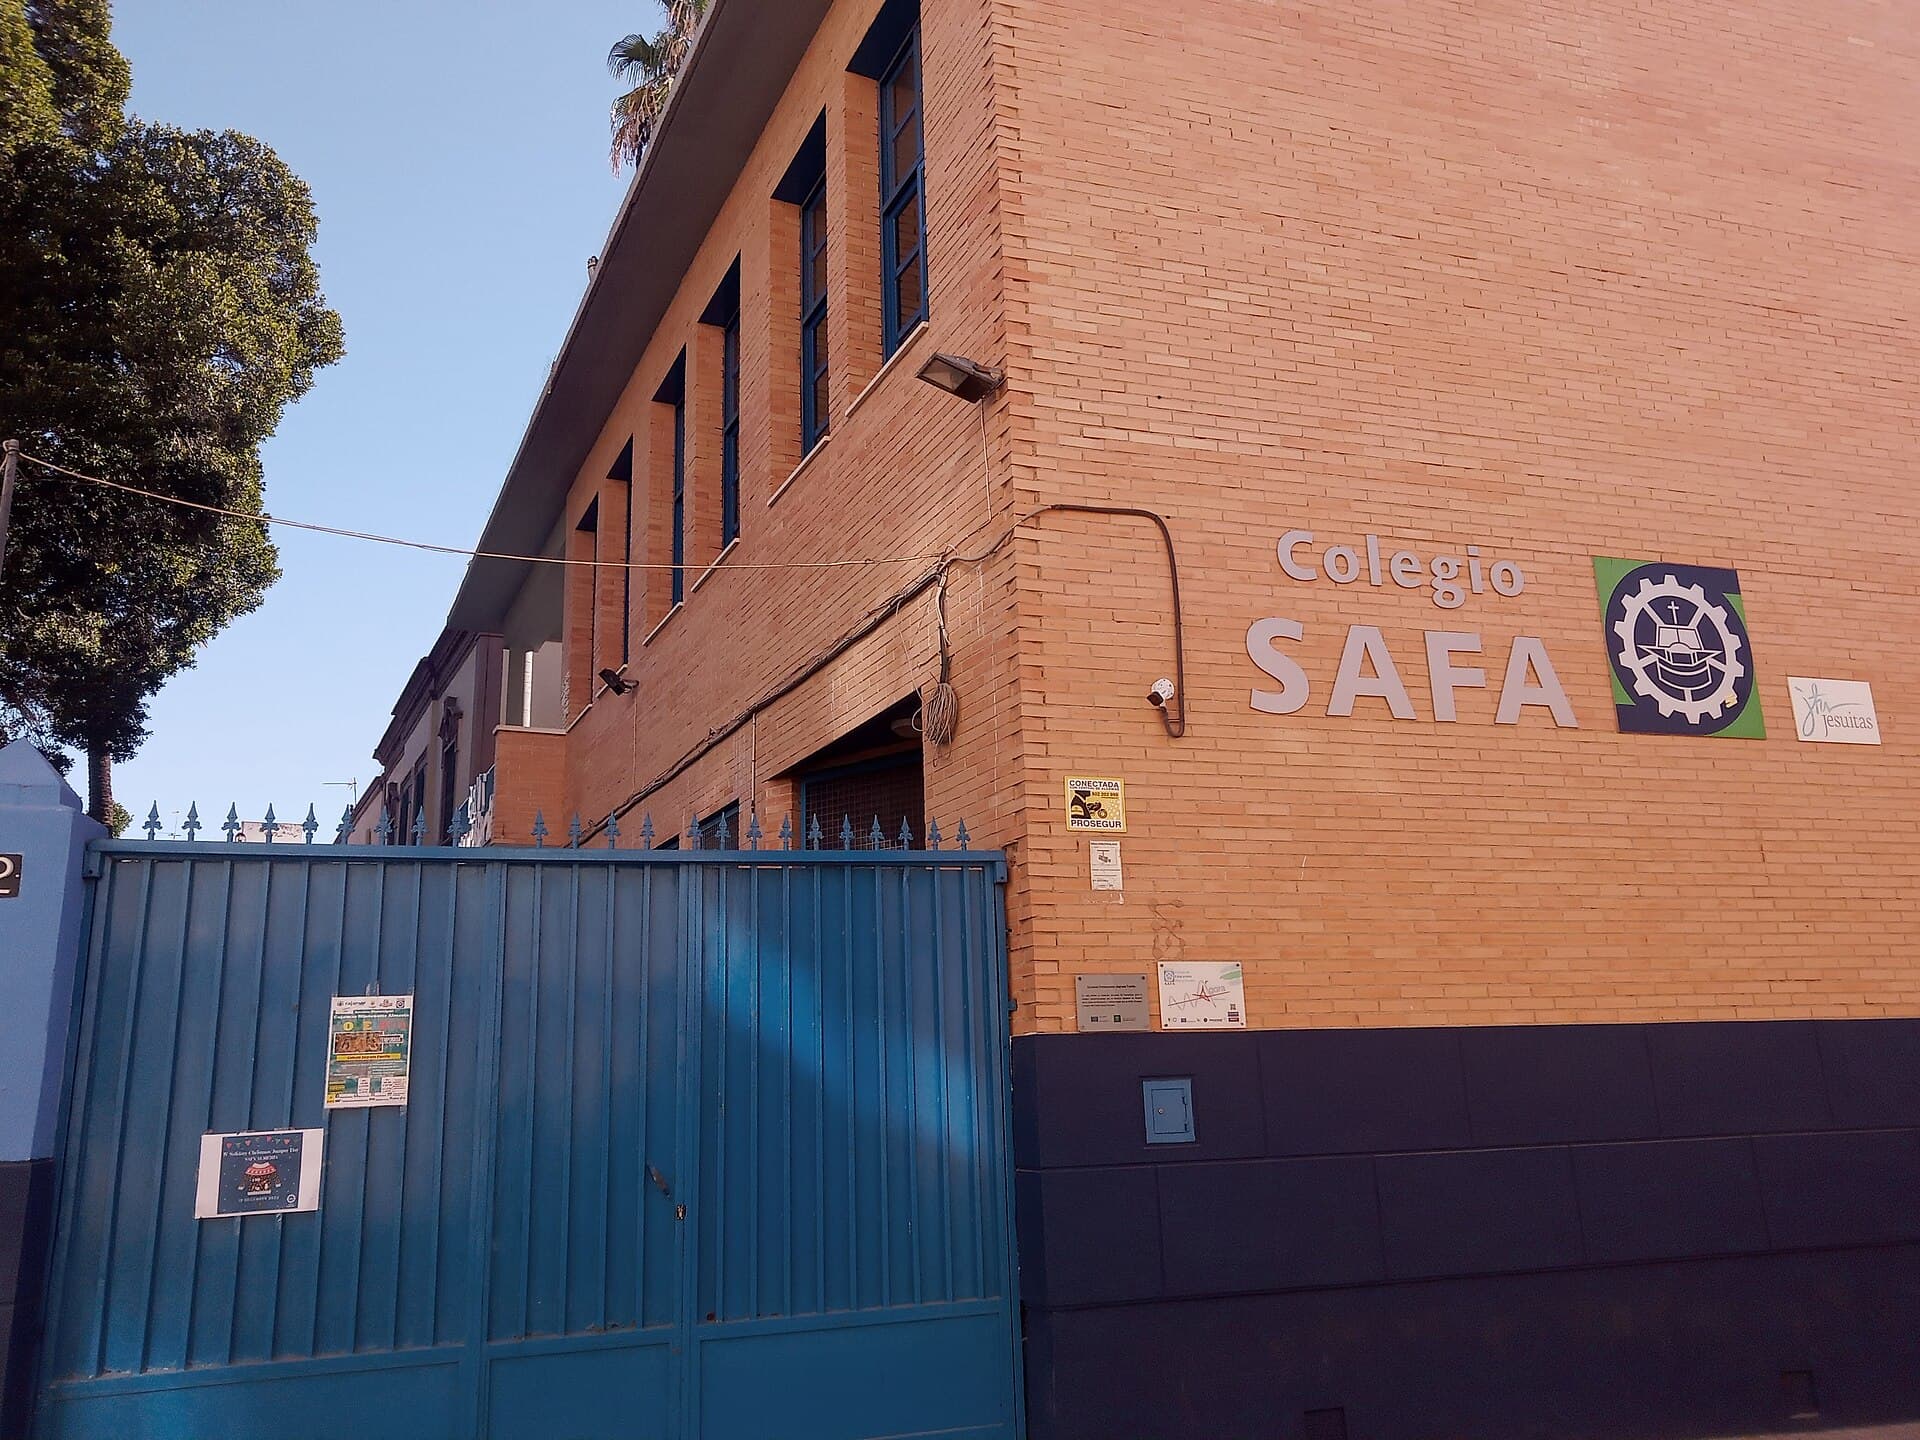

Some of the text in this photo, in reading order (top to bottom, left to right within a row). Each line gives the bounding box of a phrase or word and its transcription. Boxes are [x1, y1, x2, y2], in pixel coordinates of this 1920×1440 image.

[1276, 529, 1525, 609] Colegio
[1246, 617, 1579, 728] SAFA
[1069, 780, 1119, 788] CONECTADA
[1071, 820, 1122, 828] PROSEGUR
